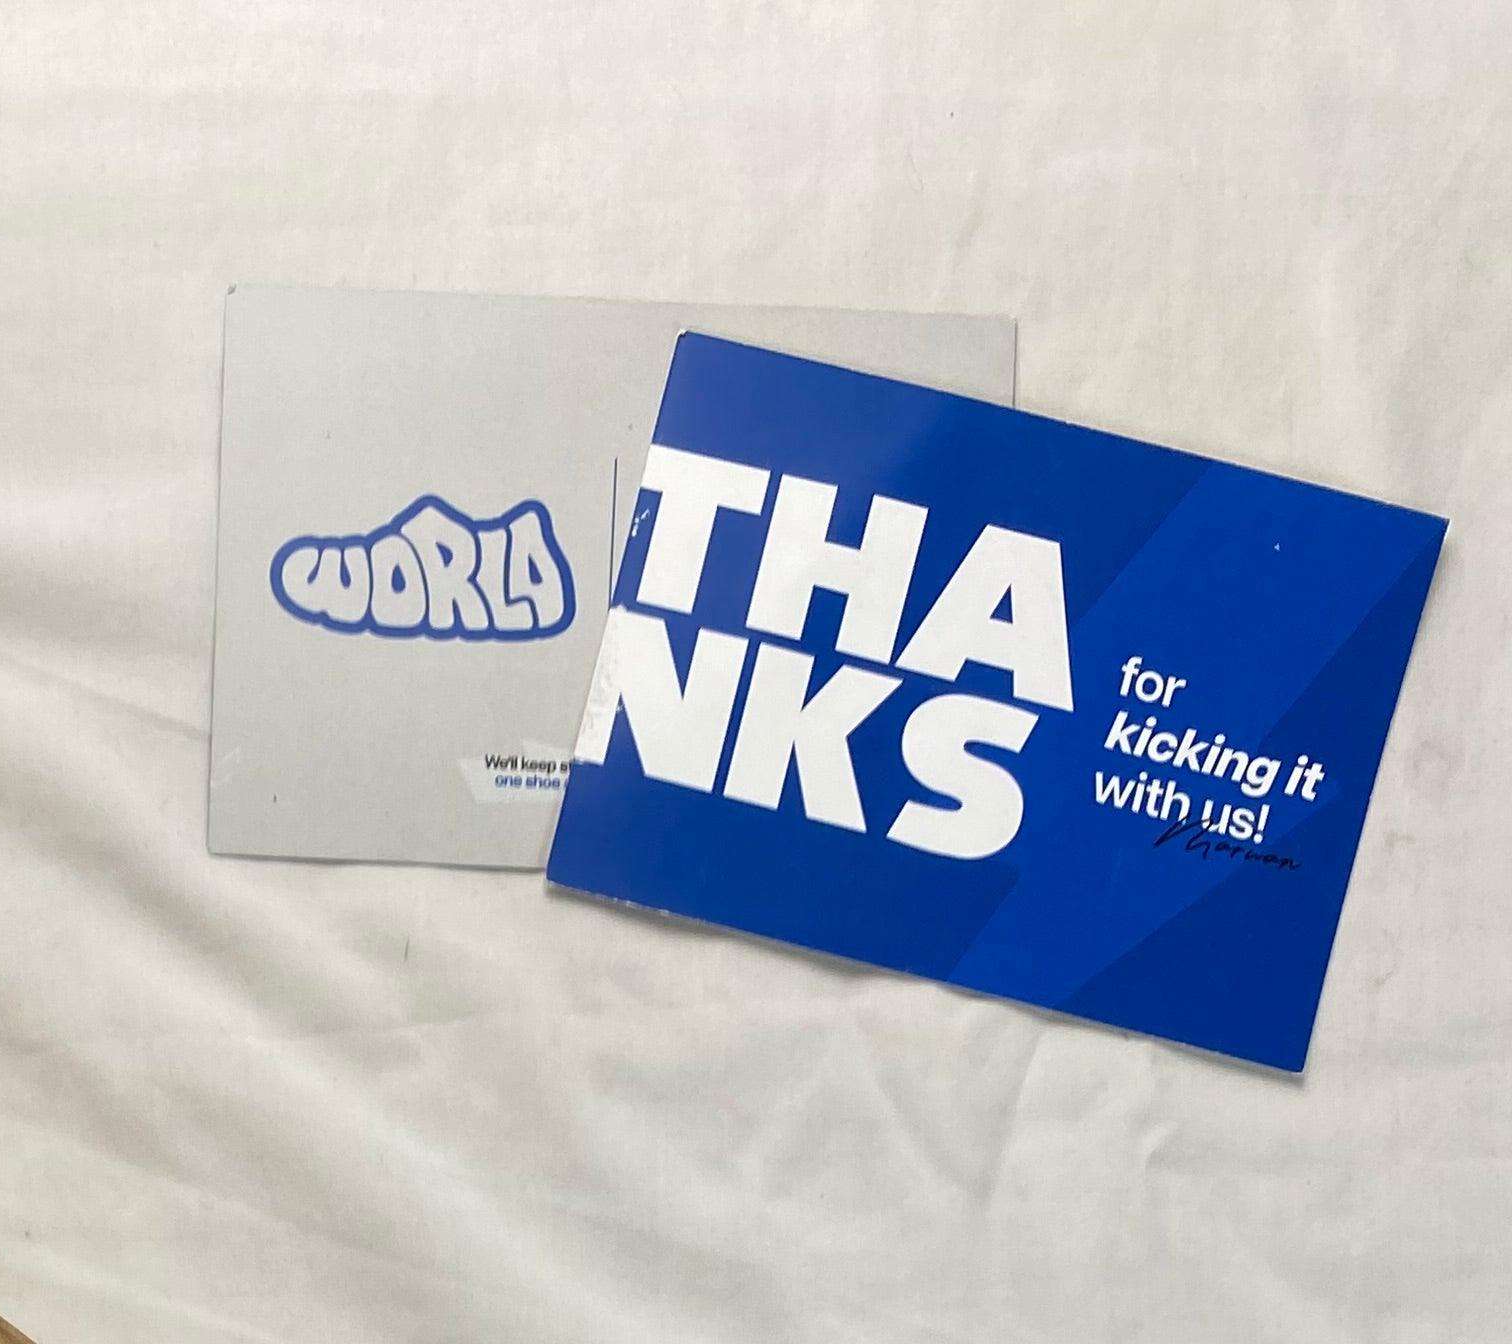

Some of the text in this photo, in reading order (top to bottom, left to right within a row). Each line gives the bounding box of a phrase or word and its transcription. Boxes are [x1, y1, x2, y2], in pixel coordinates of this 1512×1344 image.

[270, 494, 576, 642] WORLD
[638, 442, 1075, 712] THA
[1119, 655, 1187, 708] for
[485, 753, 518, 771] We'll
[521, 755, 557, 775] keep
[573, 605, 1040, 861] NKS
[1103, 710, 1326, 801] kicking it
[494, 774, 523, 788] one
[526, 774, 561, 791] shoe
[1094, 770, 1271, 845] with us!
